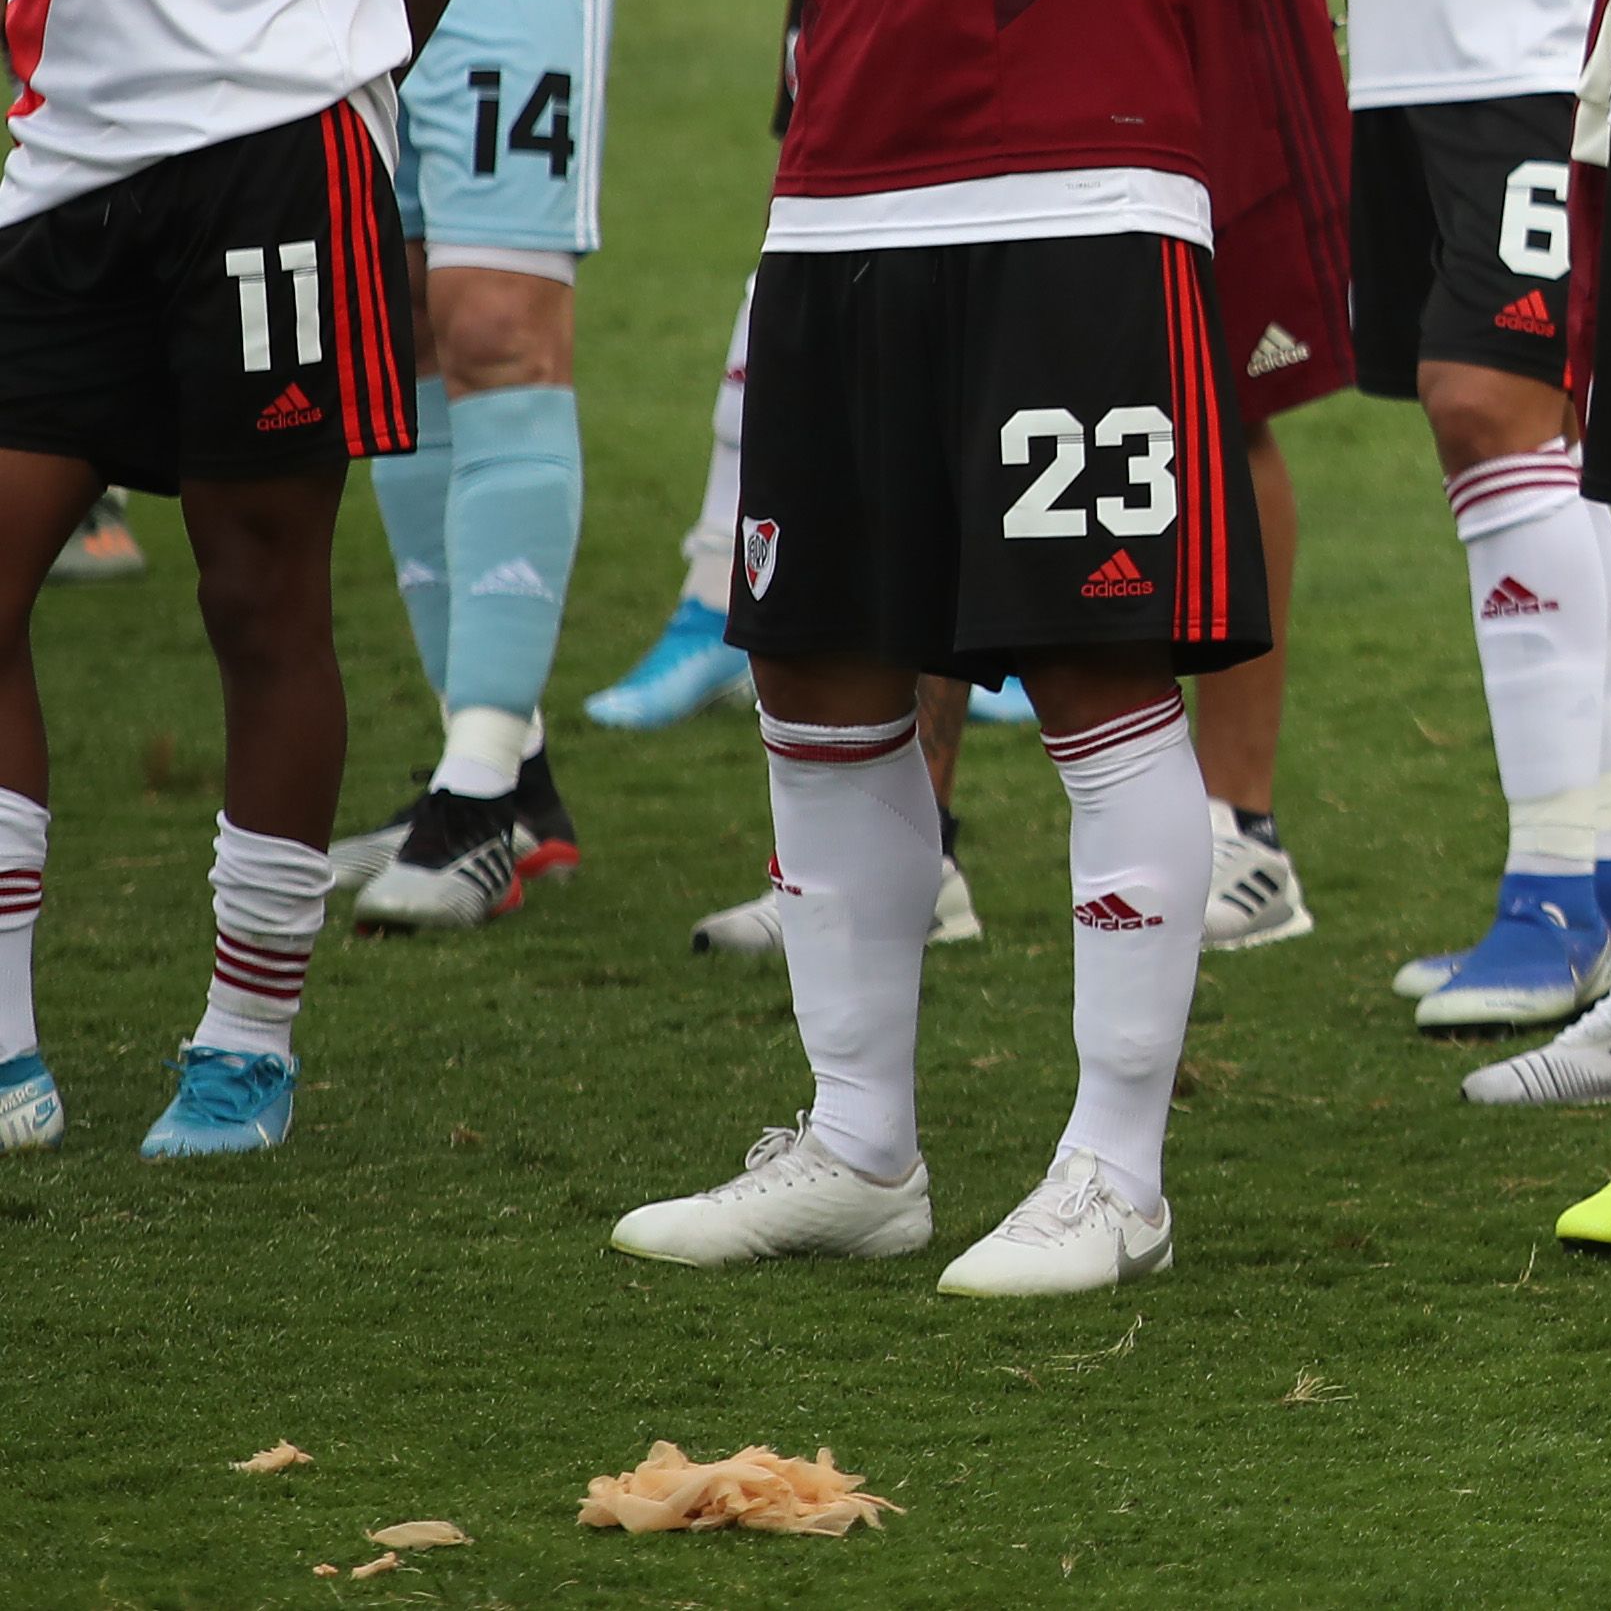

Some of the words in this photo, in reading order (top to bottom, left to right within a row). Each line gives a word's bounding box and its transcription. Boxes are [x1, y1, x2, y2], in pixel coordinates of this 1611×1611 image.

[469, 69, 574, 179] 14
[1498, 159, 1572, 281] 6
[226, 240, 322, 373] 11
[1494, 310, 1556, 339] adidas
[1246, 337, 1312, 378] adidas
[255, 405, 323, 432] adidas
[1000, 405, 1178, 540] 23
[1081, 578, 1155, 598] adidas
